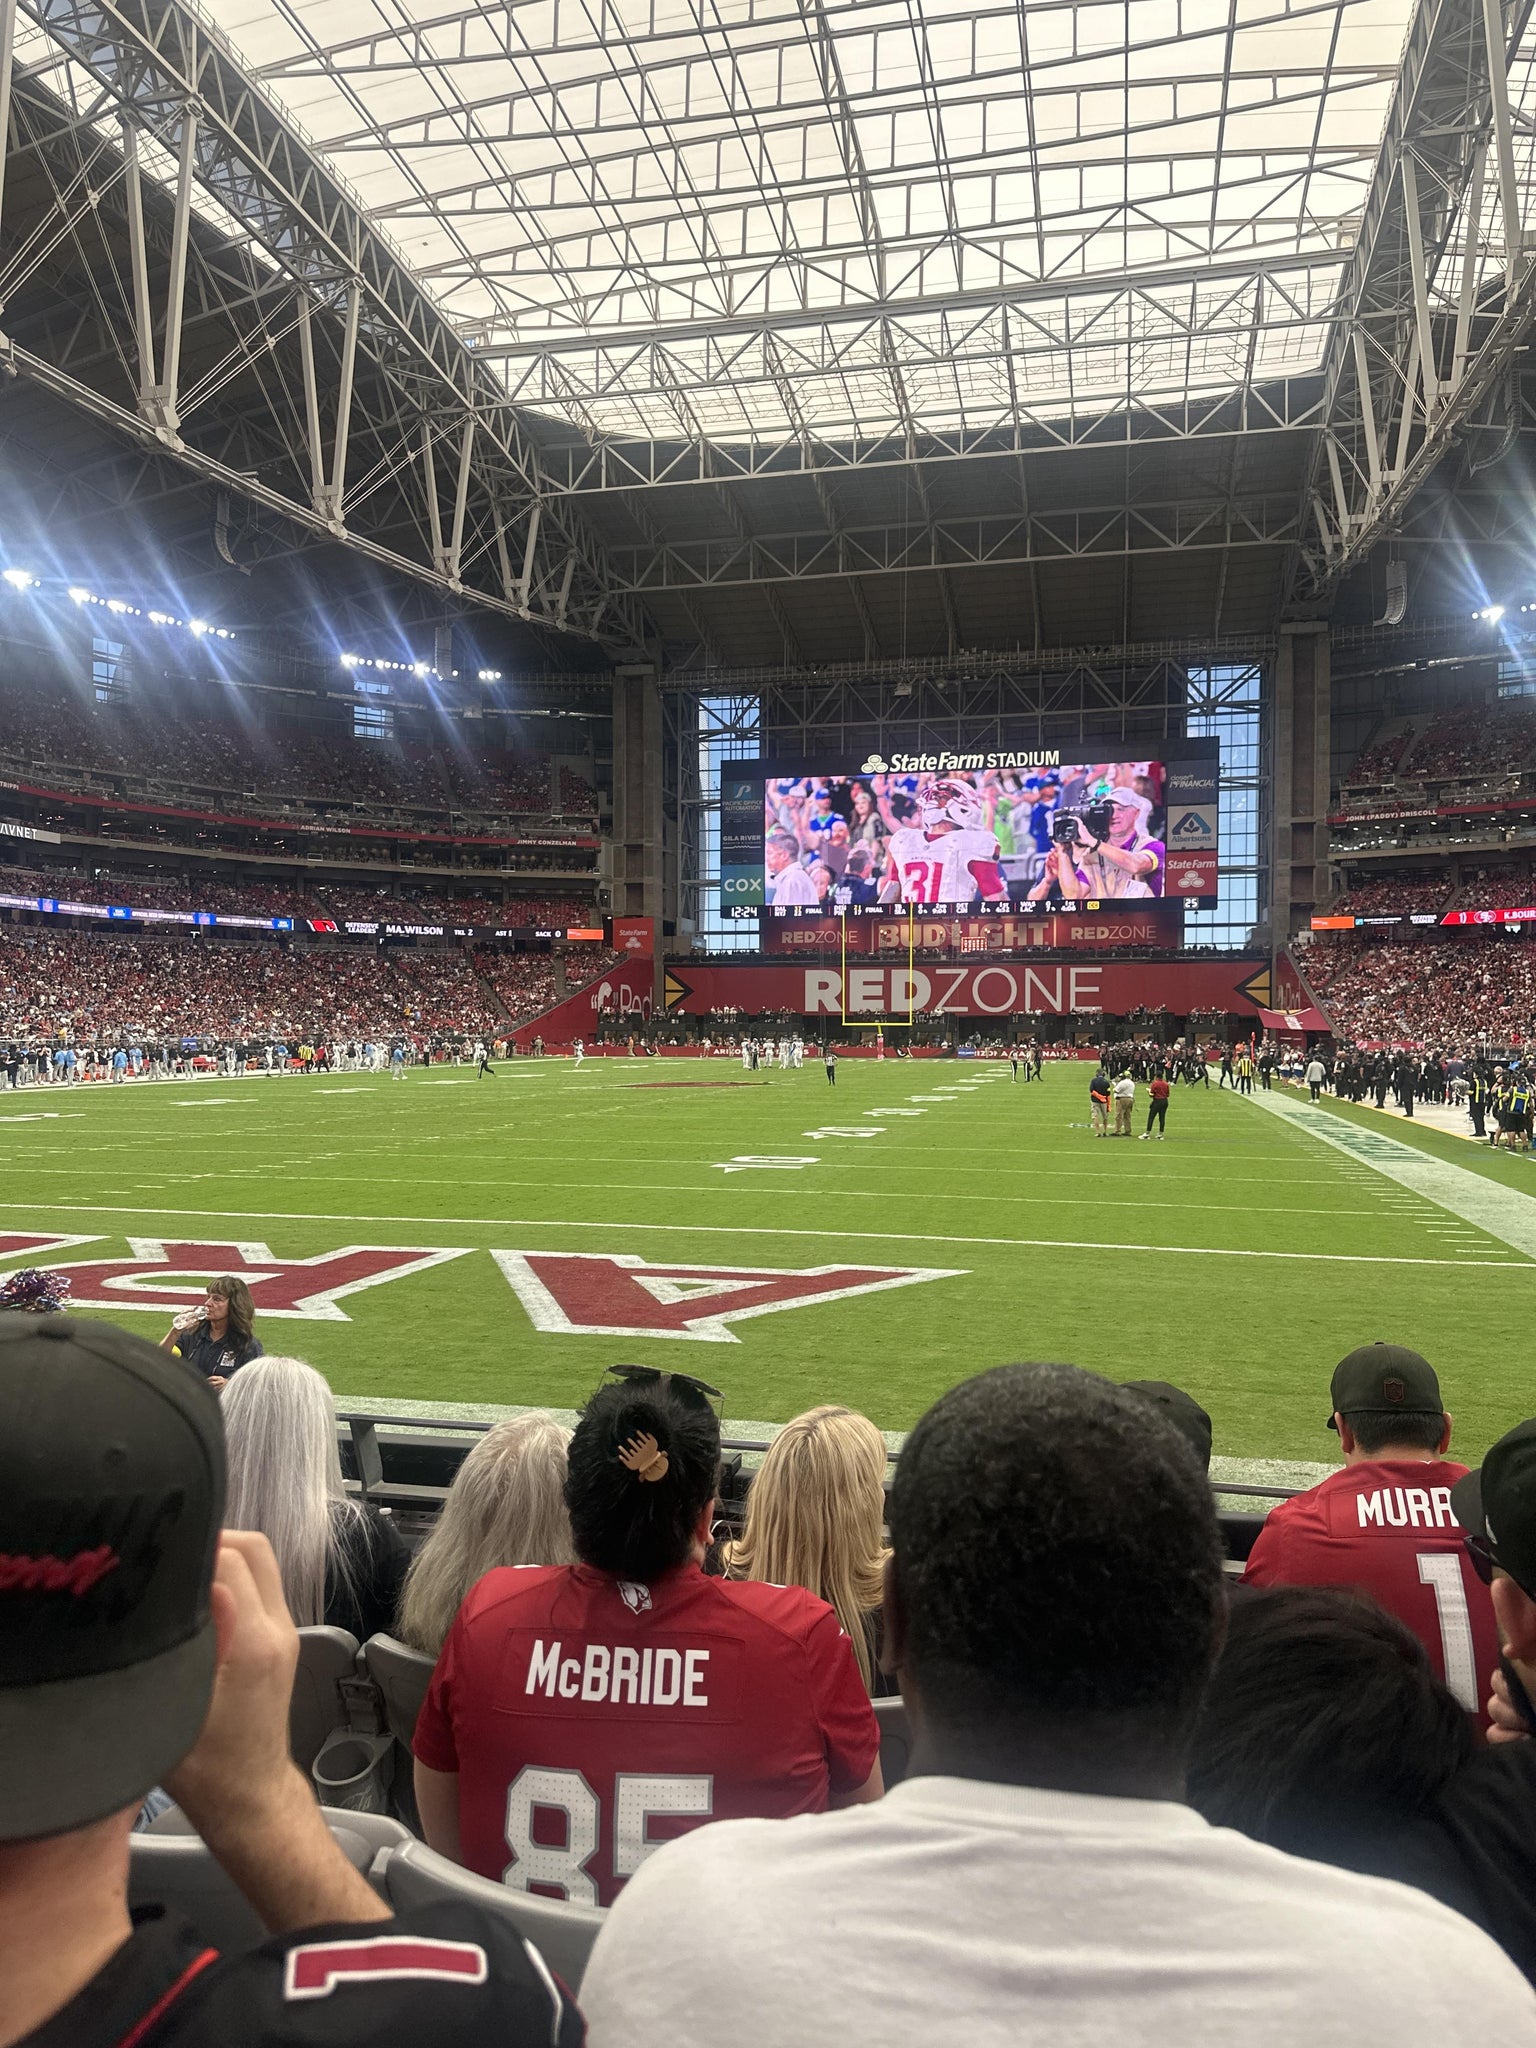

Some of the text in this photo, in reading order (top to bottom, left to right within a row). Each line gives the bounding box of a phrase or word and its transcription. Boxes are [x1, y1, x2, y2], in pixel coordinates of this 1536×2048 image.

[890, 750, 1060, 773] State Farm STADIUM
[1400, 809, 1437, 818] DRISCOLL
[0, 822, 37, 840] AVNET
[300, 825, 351, 834] ADRIAN WILSON
[1172, 834, 1211, 843] Albertsons
[1167, 858, 1215, 870] State Farm
[724, 878, 761, 892] COX
[1184, 898, 1198, 908] 25
[731, 906, 757, 918] 12:24
[878, 923, 946, 949] BUD
[951, 921, 1049, 948] LIGHT
[1071, 925, 1157, 940] REDZONE
[804, 967, 1103, 1013] REDZONE
[1356, 1486, 1460, 1529] MURR
[1416, 1552, 1480, 1713] 1
[525, 1639, 710, 1707] McBRIDE
